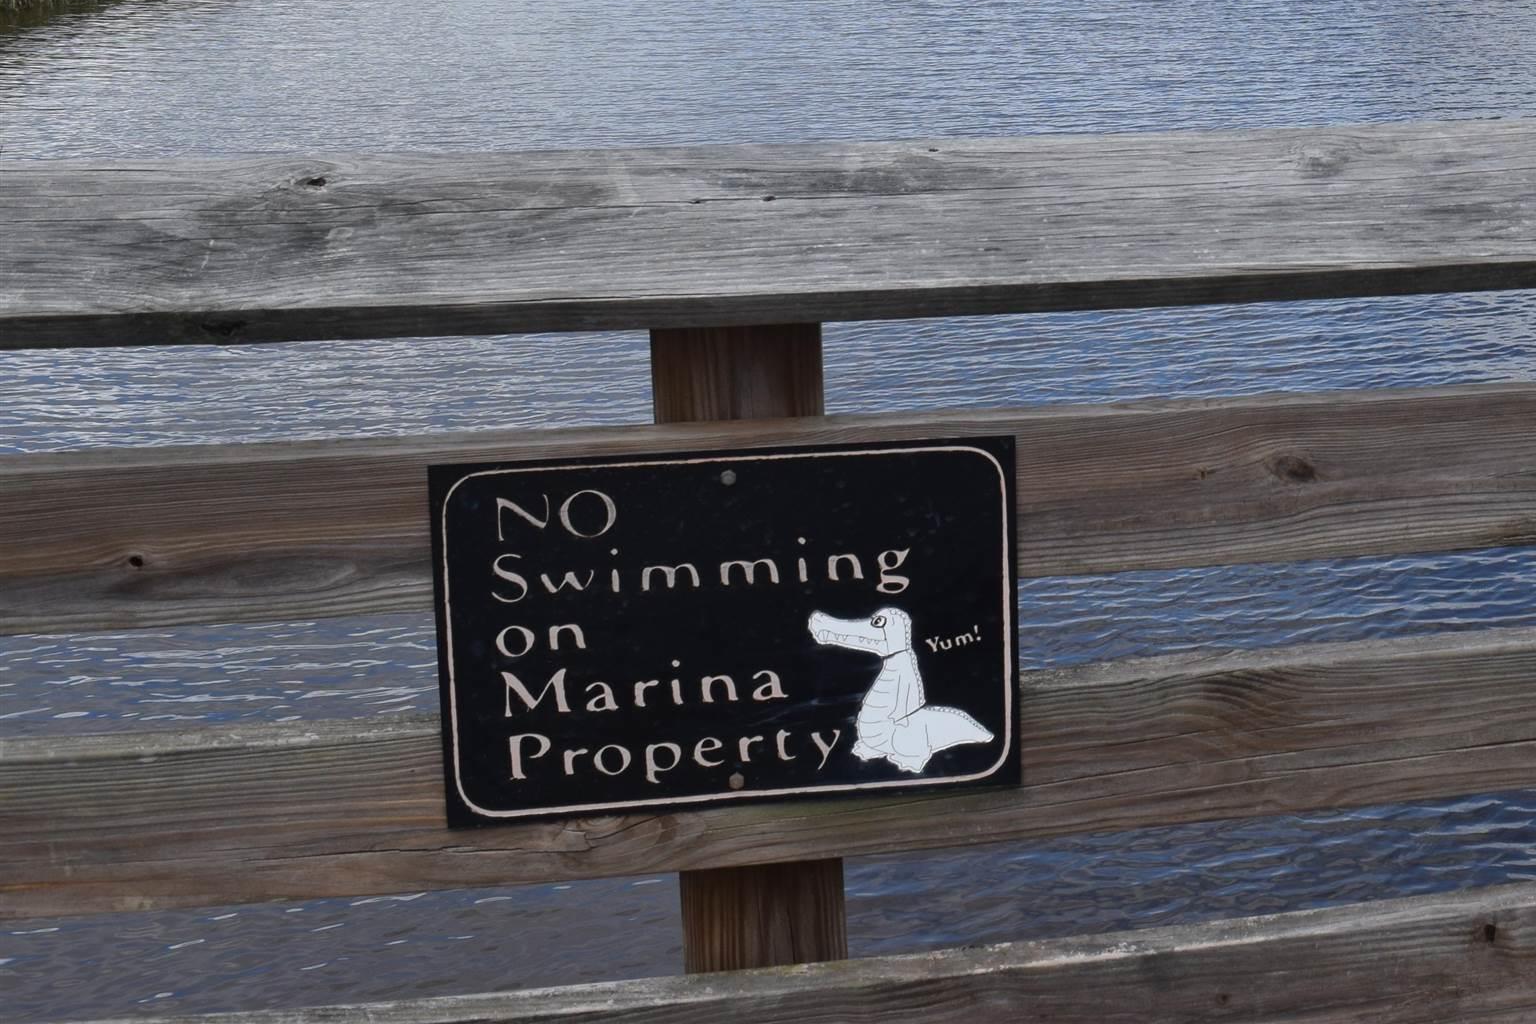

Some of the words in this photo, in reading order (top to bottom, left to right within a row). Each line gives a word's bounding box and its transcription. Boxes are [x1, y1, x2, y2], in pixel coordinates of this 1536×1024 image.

[496, 489, 617, 542] NO
[491, 537, 910, 603] Swimming
[495, 623, 587, 658] on
[925, 624, 982, 653] Yum!
[500, 659, 788, 718] Marina
[508, 728, 841, 785] Property
